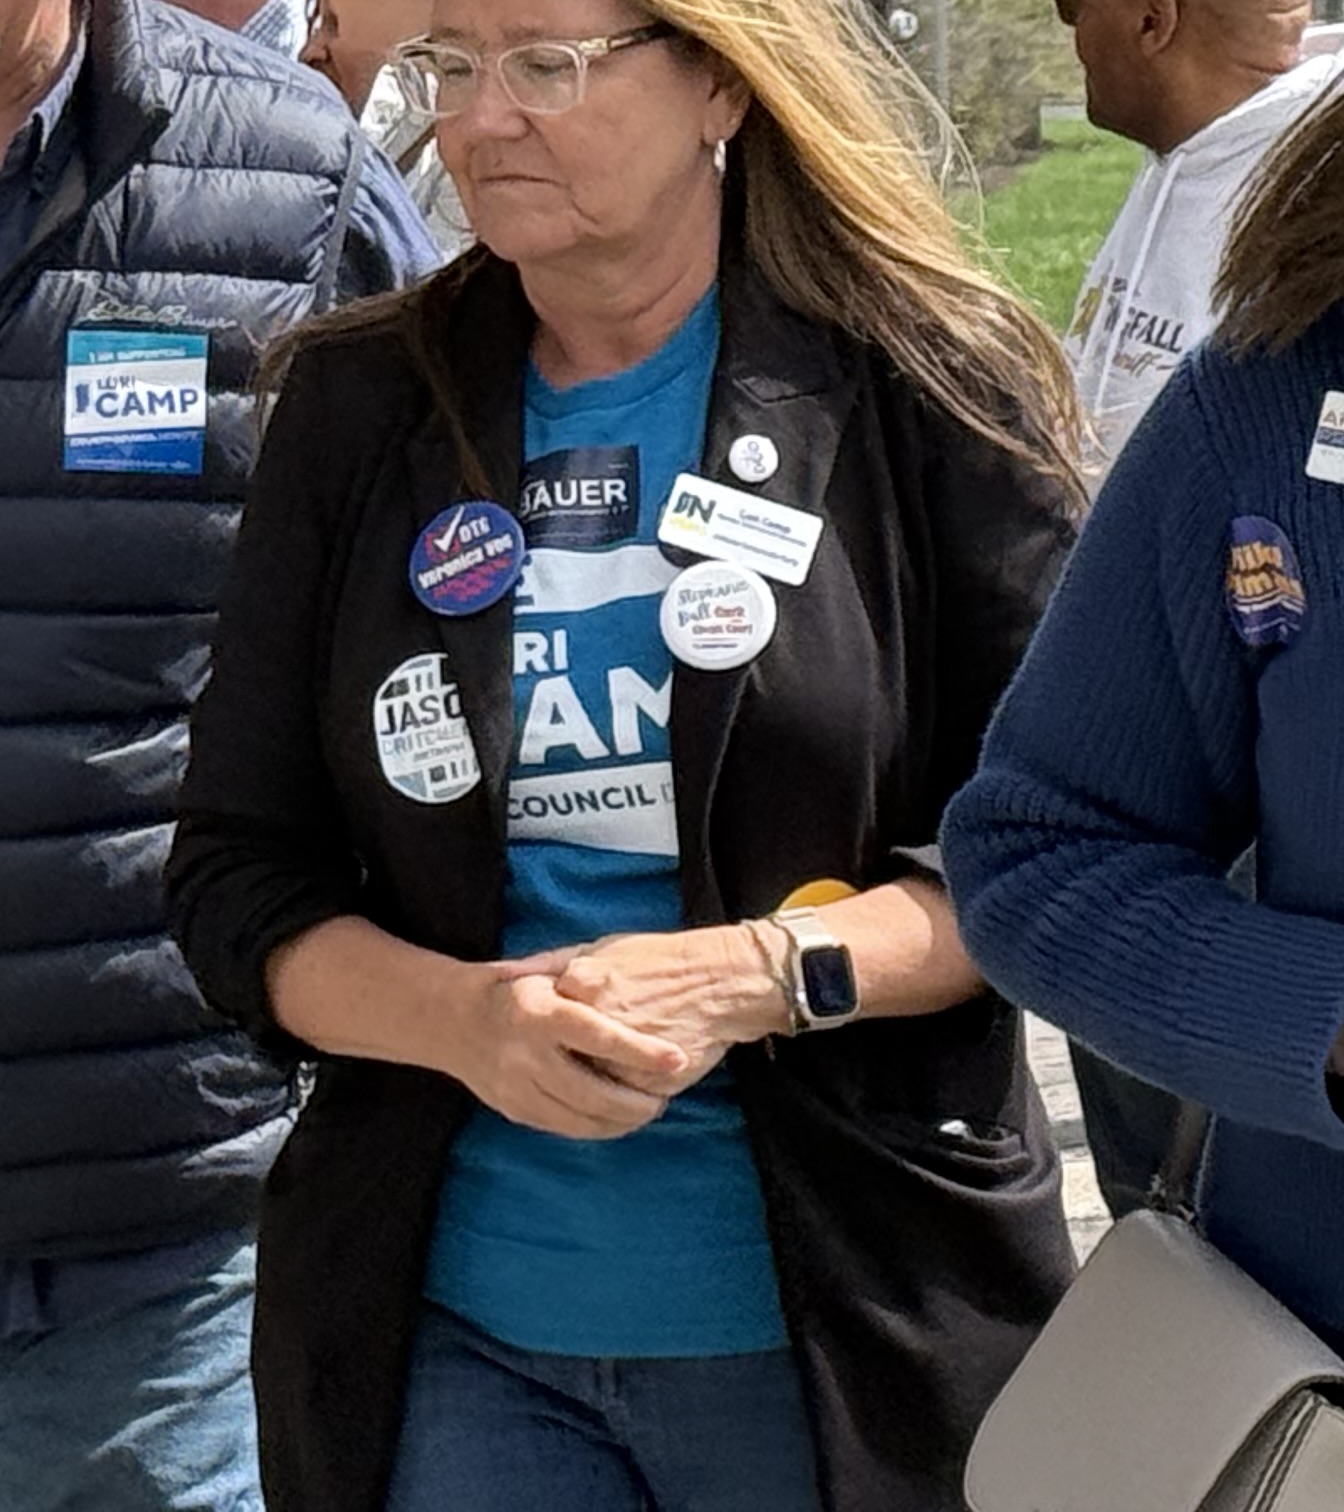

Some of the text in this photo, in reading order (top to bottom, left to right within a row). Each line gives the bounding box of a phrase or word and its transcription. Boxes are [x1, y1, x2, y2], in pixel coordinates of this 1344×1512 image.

[94, 388, 200, 419] CAMP
[512, 629, 569, 676] RI
[506, 783, 657, 820] COUNCIL
